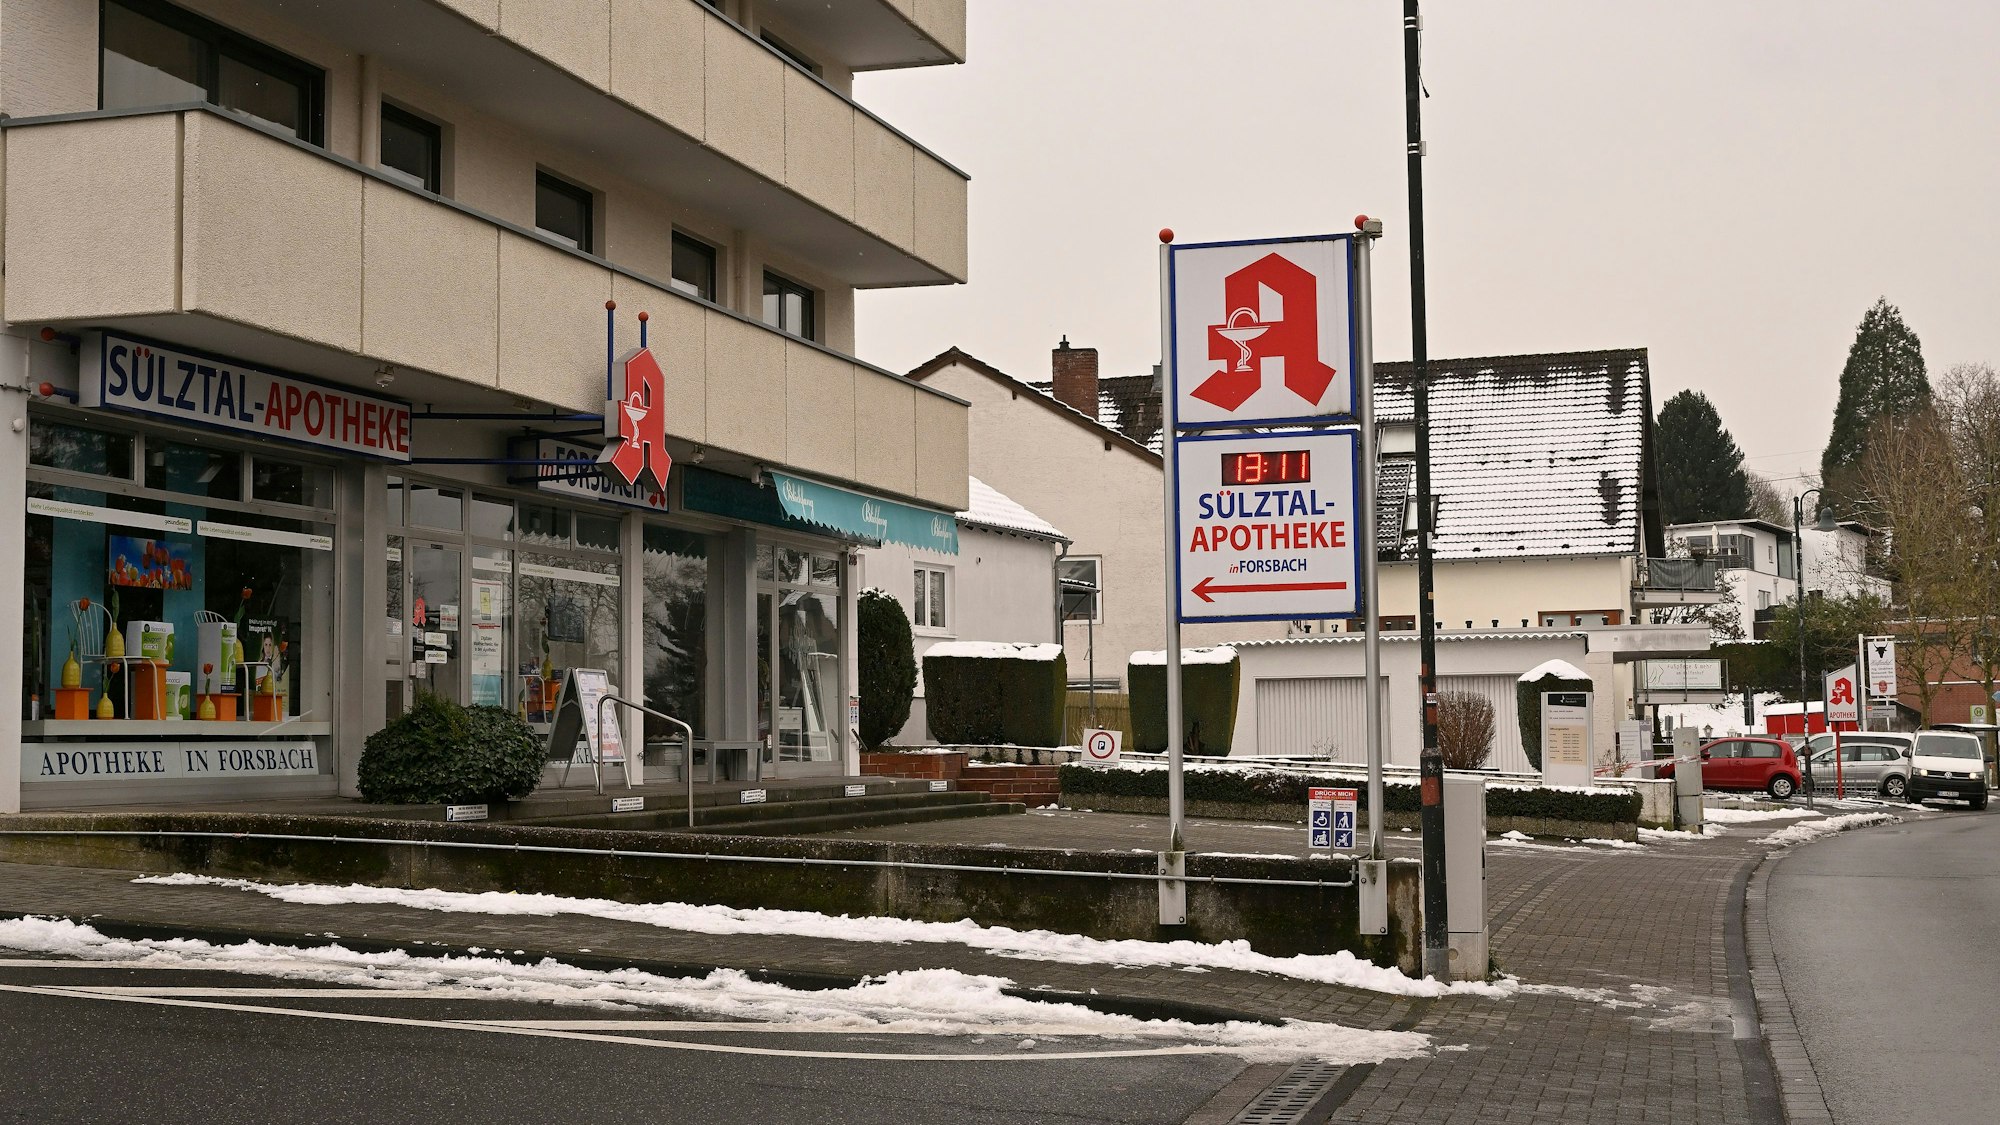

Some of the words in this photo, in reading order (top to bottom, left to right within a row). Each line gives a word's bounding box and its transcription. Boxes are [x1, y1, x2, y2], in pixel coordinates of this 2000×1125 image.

[108, 345, 410, 454] SÜLZTAL-APOTHEKE
[1237, 453, 1306, 482] 13:11
[1198, 489, 1335, 520] SÜLZTAL-
[1190, 521, 1346, 552] APOTHEKE
[41, 750, 165, 776] APOTHEKE
[186, 749, 209, 772] IN
[218, 748, 314, 771] FORSBACH
